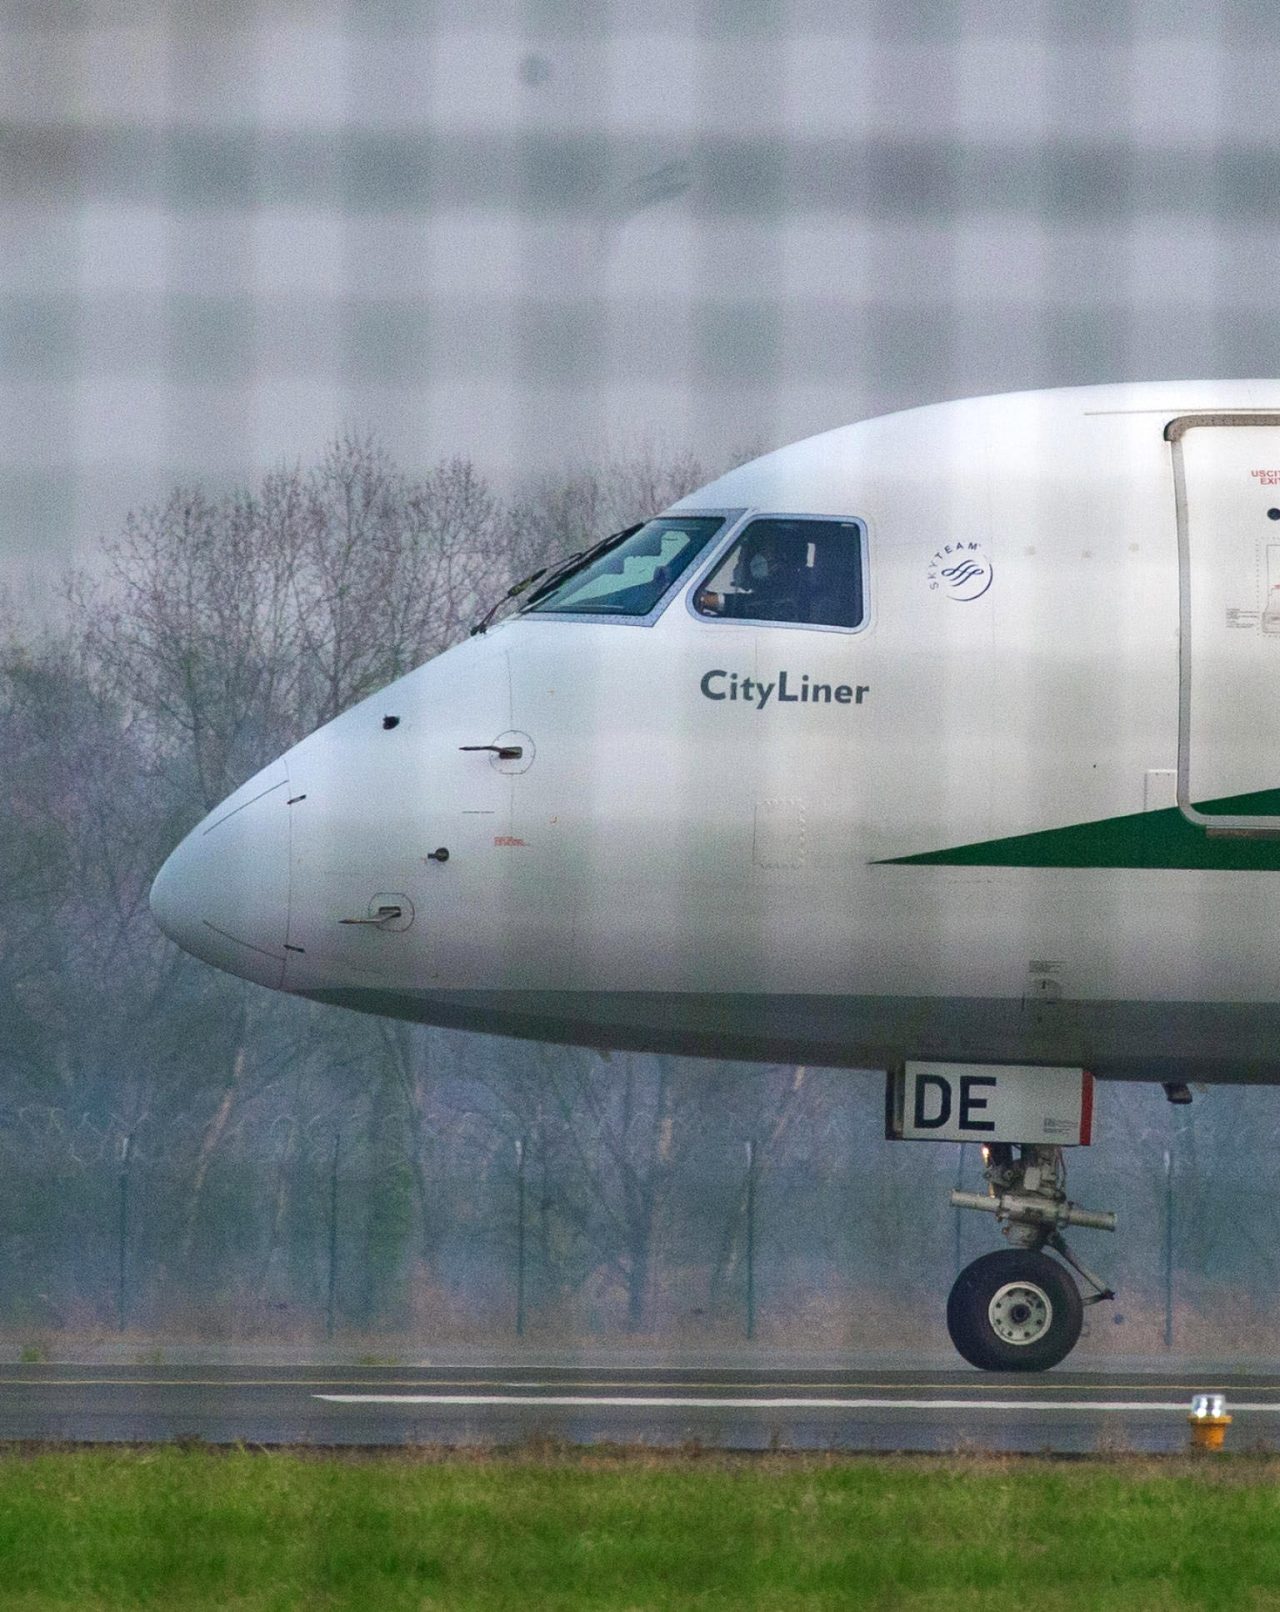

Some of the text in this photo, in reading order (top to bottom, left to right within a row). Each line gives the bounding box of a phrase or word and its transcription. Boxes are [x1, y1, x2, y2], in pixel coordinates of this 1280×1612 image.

[928, 542, 978, 590] SKYTEAM
[700, 669, 870, 709] CityLiner
[914, 1073, 997, 1131] DE
